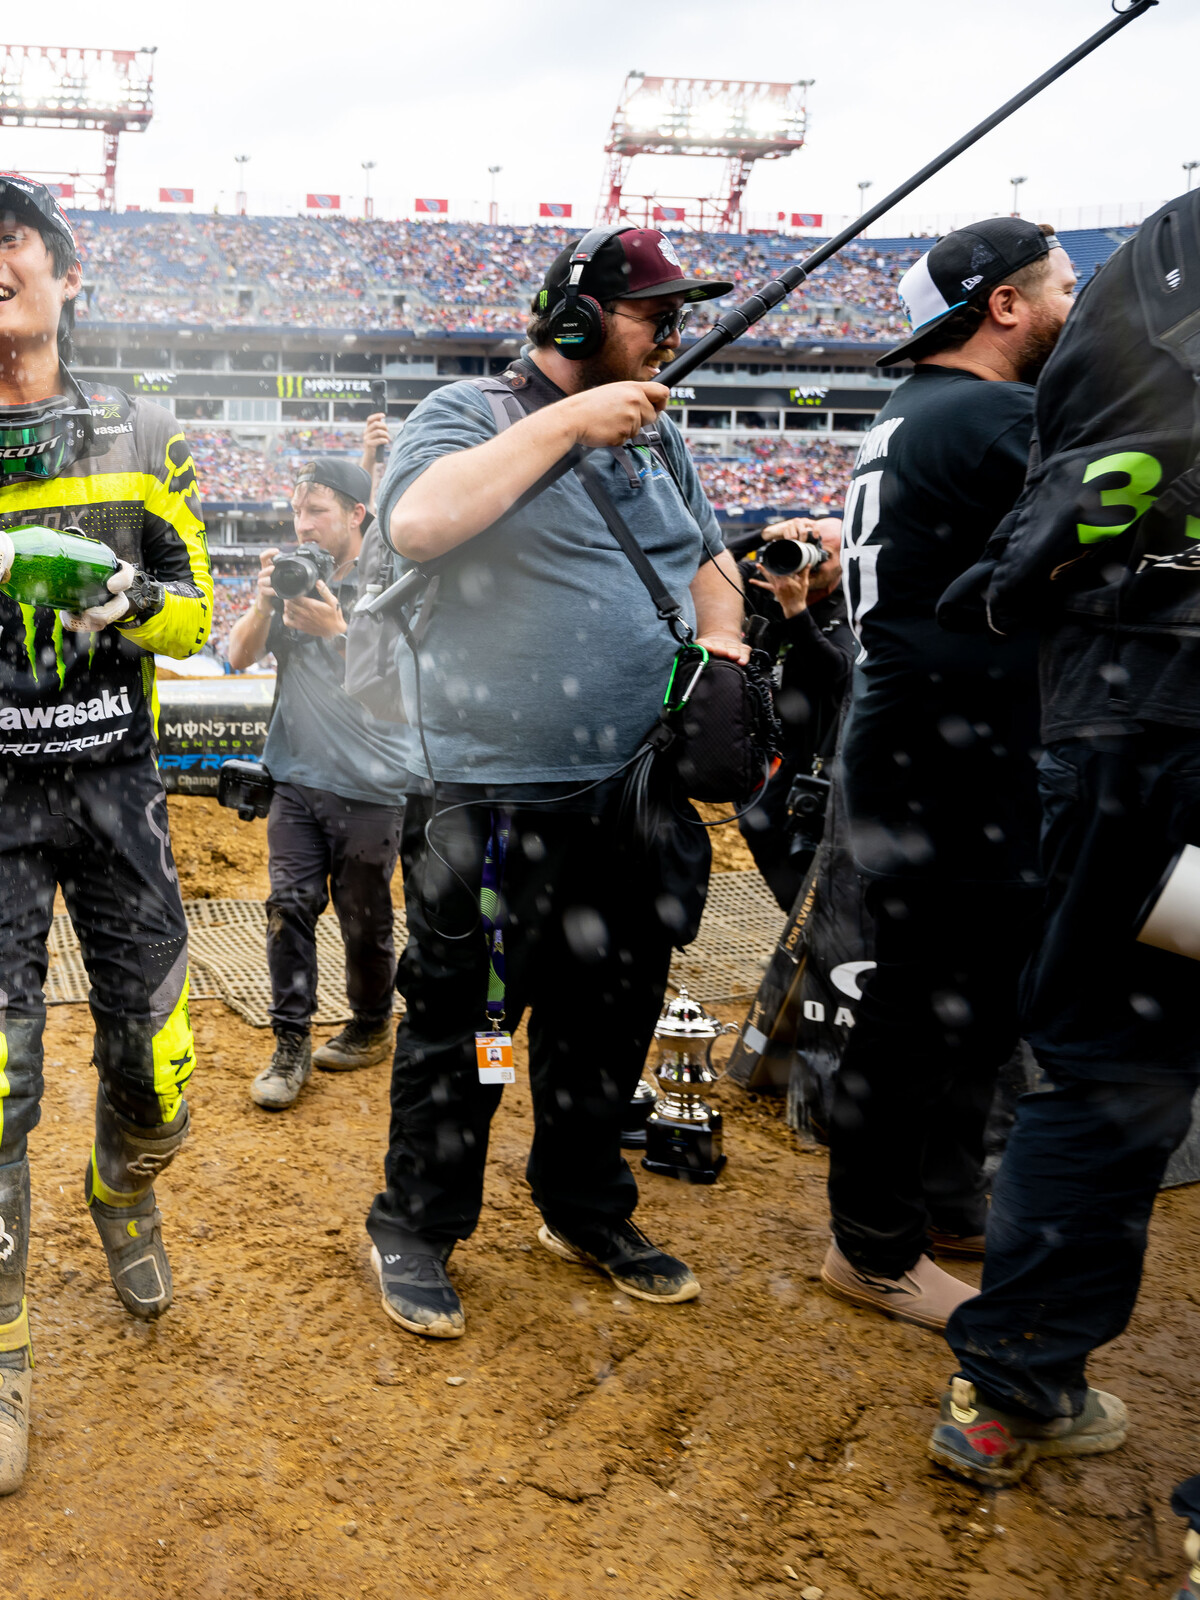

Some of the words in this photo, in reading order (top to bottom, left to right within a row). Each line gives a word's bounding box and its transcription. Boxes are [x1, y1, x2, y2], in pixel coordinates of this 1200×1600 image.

[304, 378, 372, 392] MONSTER
[164, 719, 269, 739] MONSTER
[42, 728, 129, 754] CIRCUIT
[181, 740, 254, 748] ENERGY
[785, 926, 802, 951] FOR
[797, 888, 817, 926] EVERY
